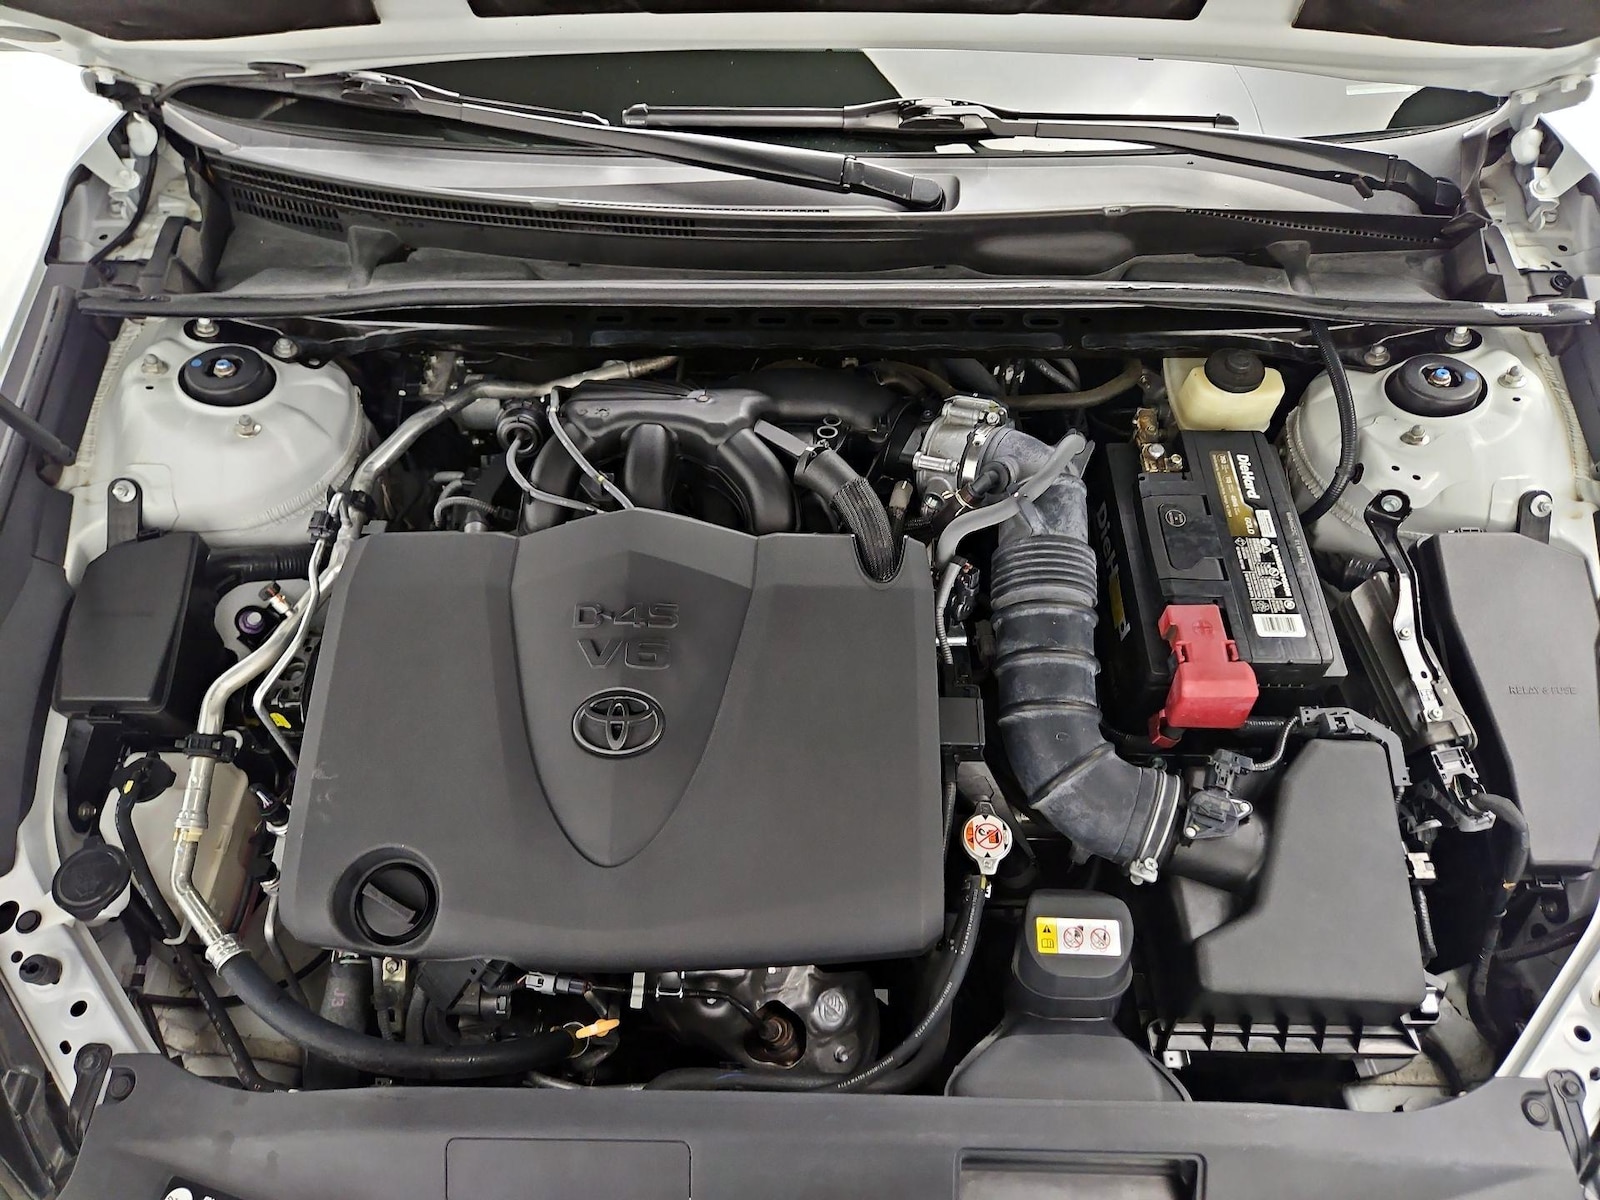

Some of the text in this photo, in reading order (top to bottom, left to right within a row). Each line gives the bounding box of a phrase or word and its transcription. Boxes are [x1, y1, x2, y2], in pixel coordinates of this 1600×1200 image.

[1236, 454, 1260, 499] DieHard
[1244, 517, 1255, 535] GOLD
[576, 637, 671, 670] V6
[1508, 685, 1540, 695] RELAY
[1551, 686, 1577, 695] FUSE
